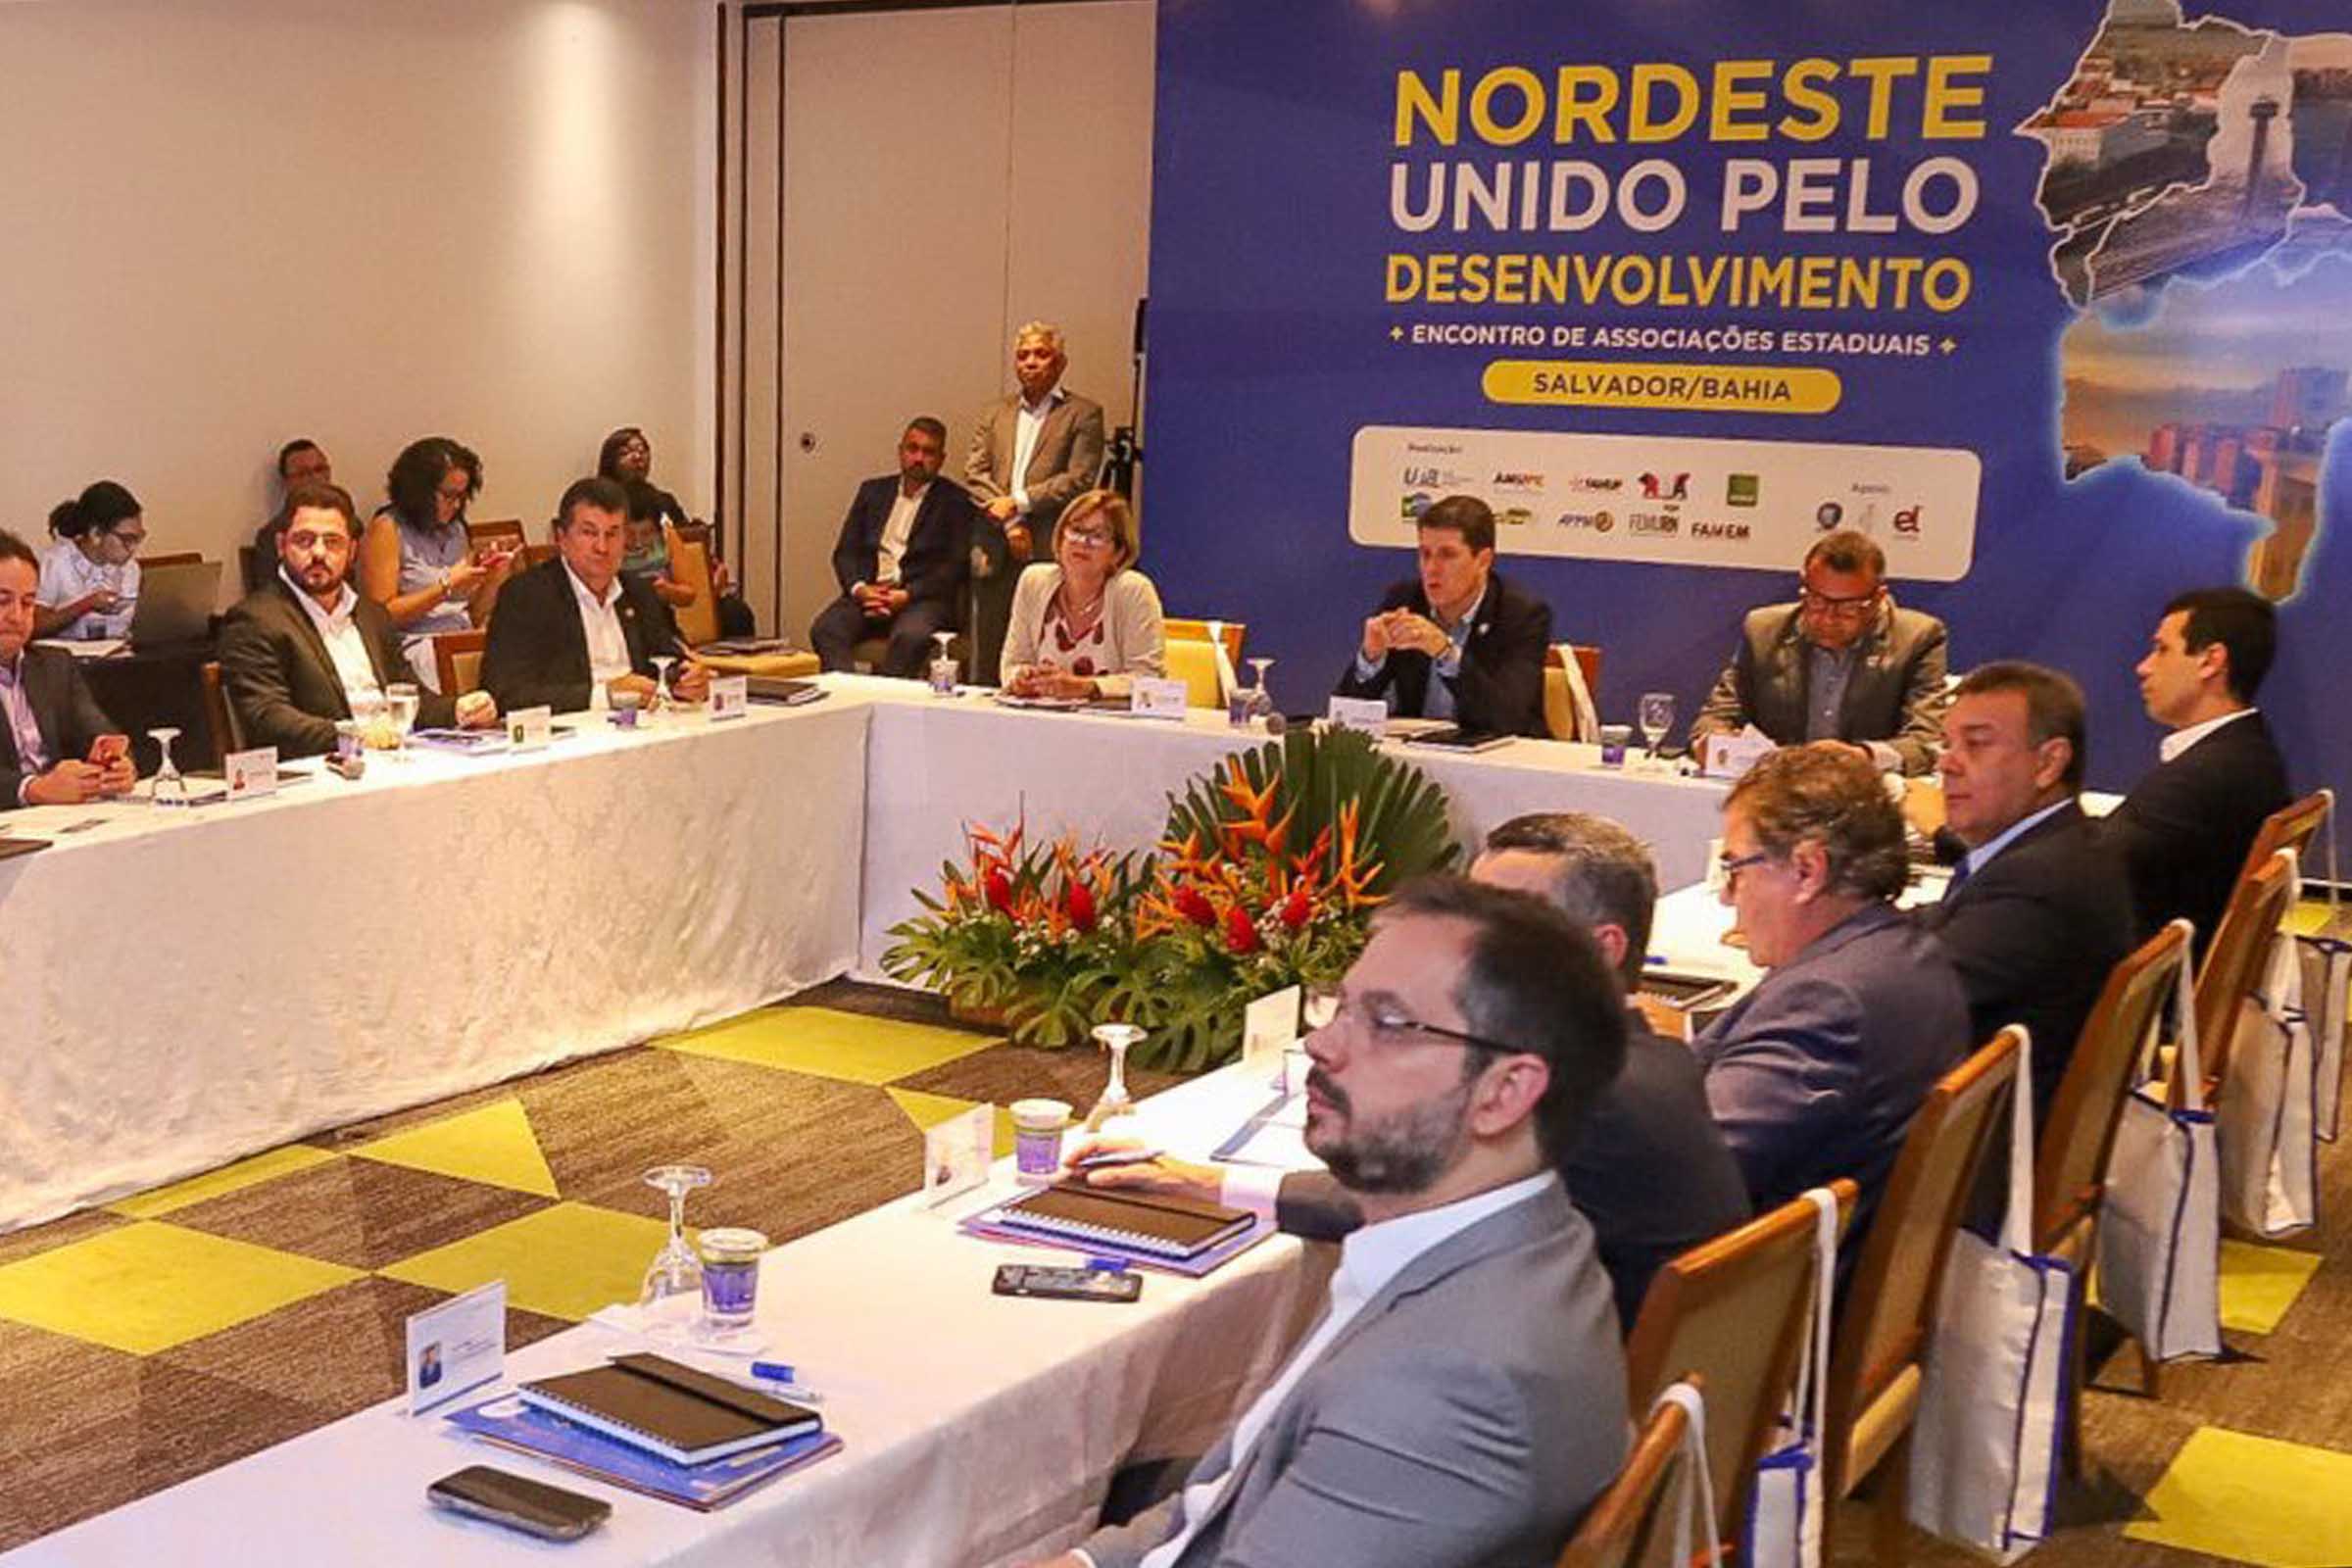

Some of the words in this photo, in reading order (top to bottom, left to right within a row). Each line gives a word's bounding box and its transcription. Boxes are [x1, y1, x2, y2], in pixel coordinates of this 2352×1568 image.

[1394, 54, 1994, 146] NORDESTE
[1390, 158, 1687, 232] UNIDO
[1720, 156, 1980, 234] PELO
[1385, 252, 1972, 312] DESENVOLVIMENTO
[1412, 324, 1545, 346] ENCONTRO
[1552, 326, 1587, 347] DE
[1592, 325, 1775, 353] ASSOCIAÇÕES
[1781, 331, 1931, 356] ESTADUAIS
[1533, 372, 1792, 402] SALVADOR/BAHIA
